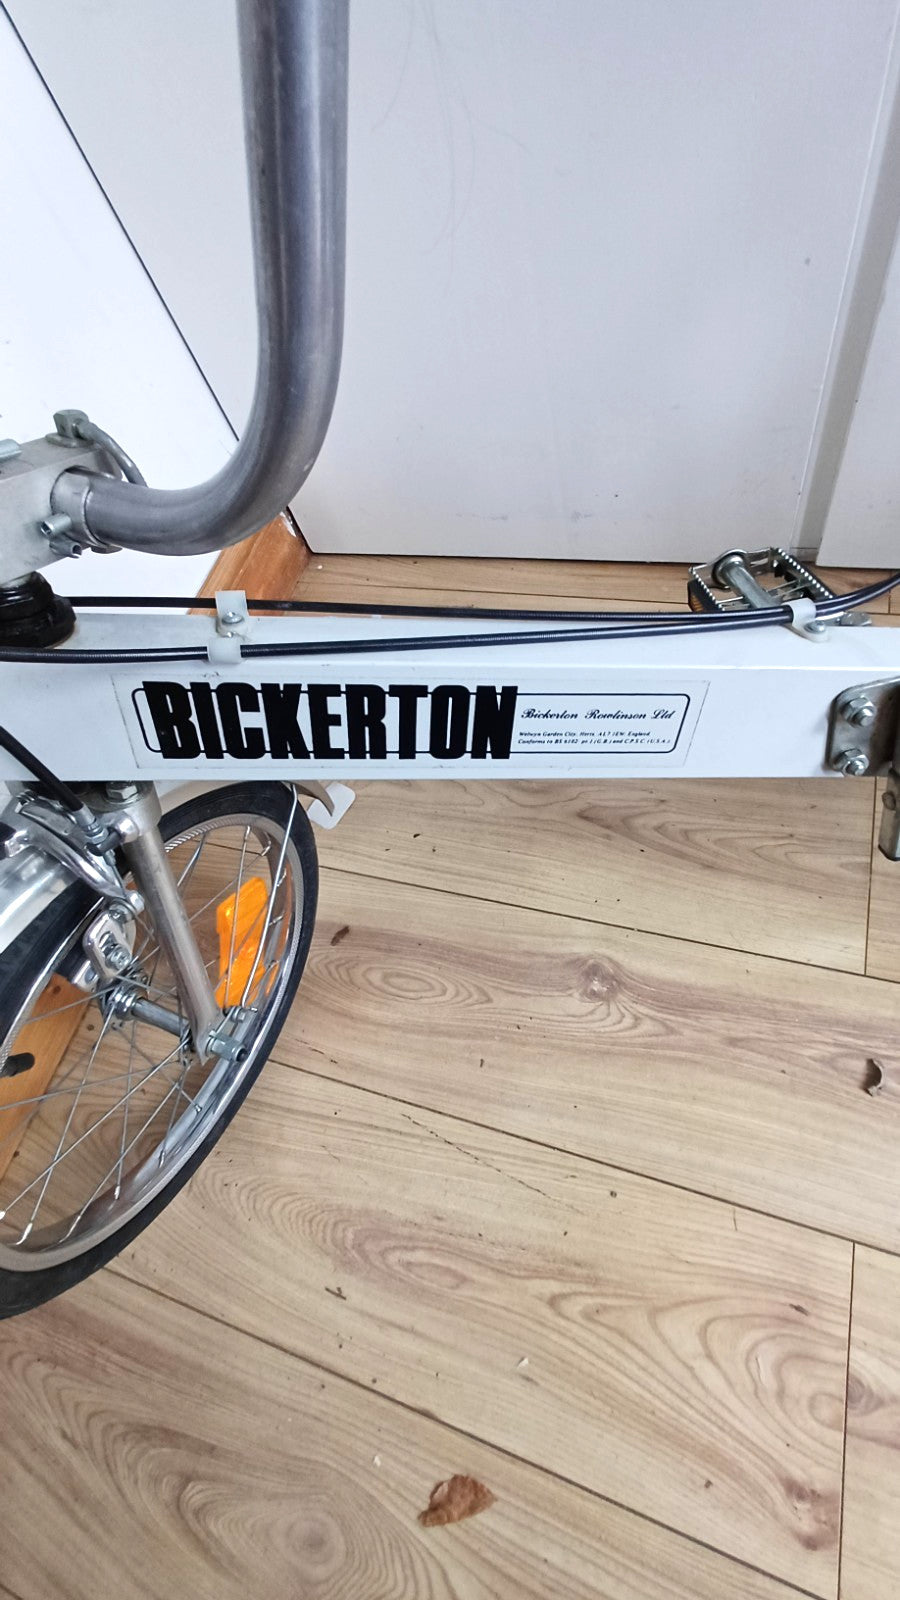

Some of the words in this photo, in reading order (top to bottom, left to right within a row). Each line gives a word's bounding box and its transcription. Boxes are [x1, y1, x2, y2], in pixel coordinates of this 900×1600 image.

[142, 681, 518, 760] BICKERTON
[521, 708, 578, 720] Bickerton
[584, 708, 646, 720] Rowlinson
[651, 708, 676, 720] Ltd
